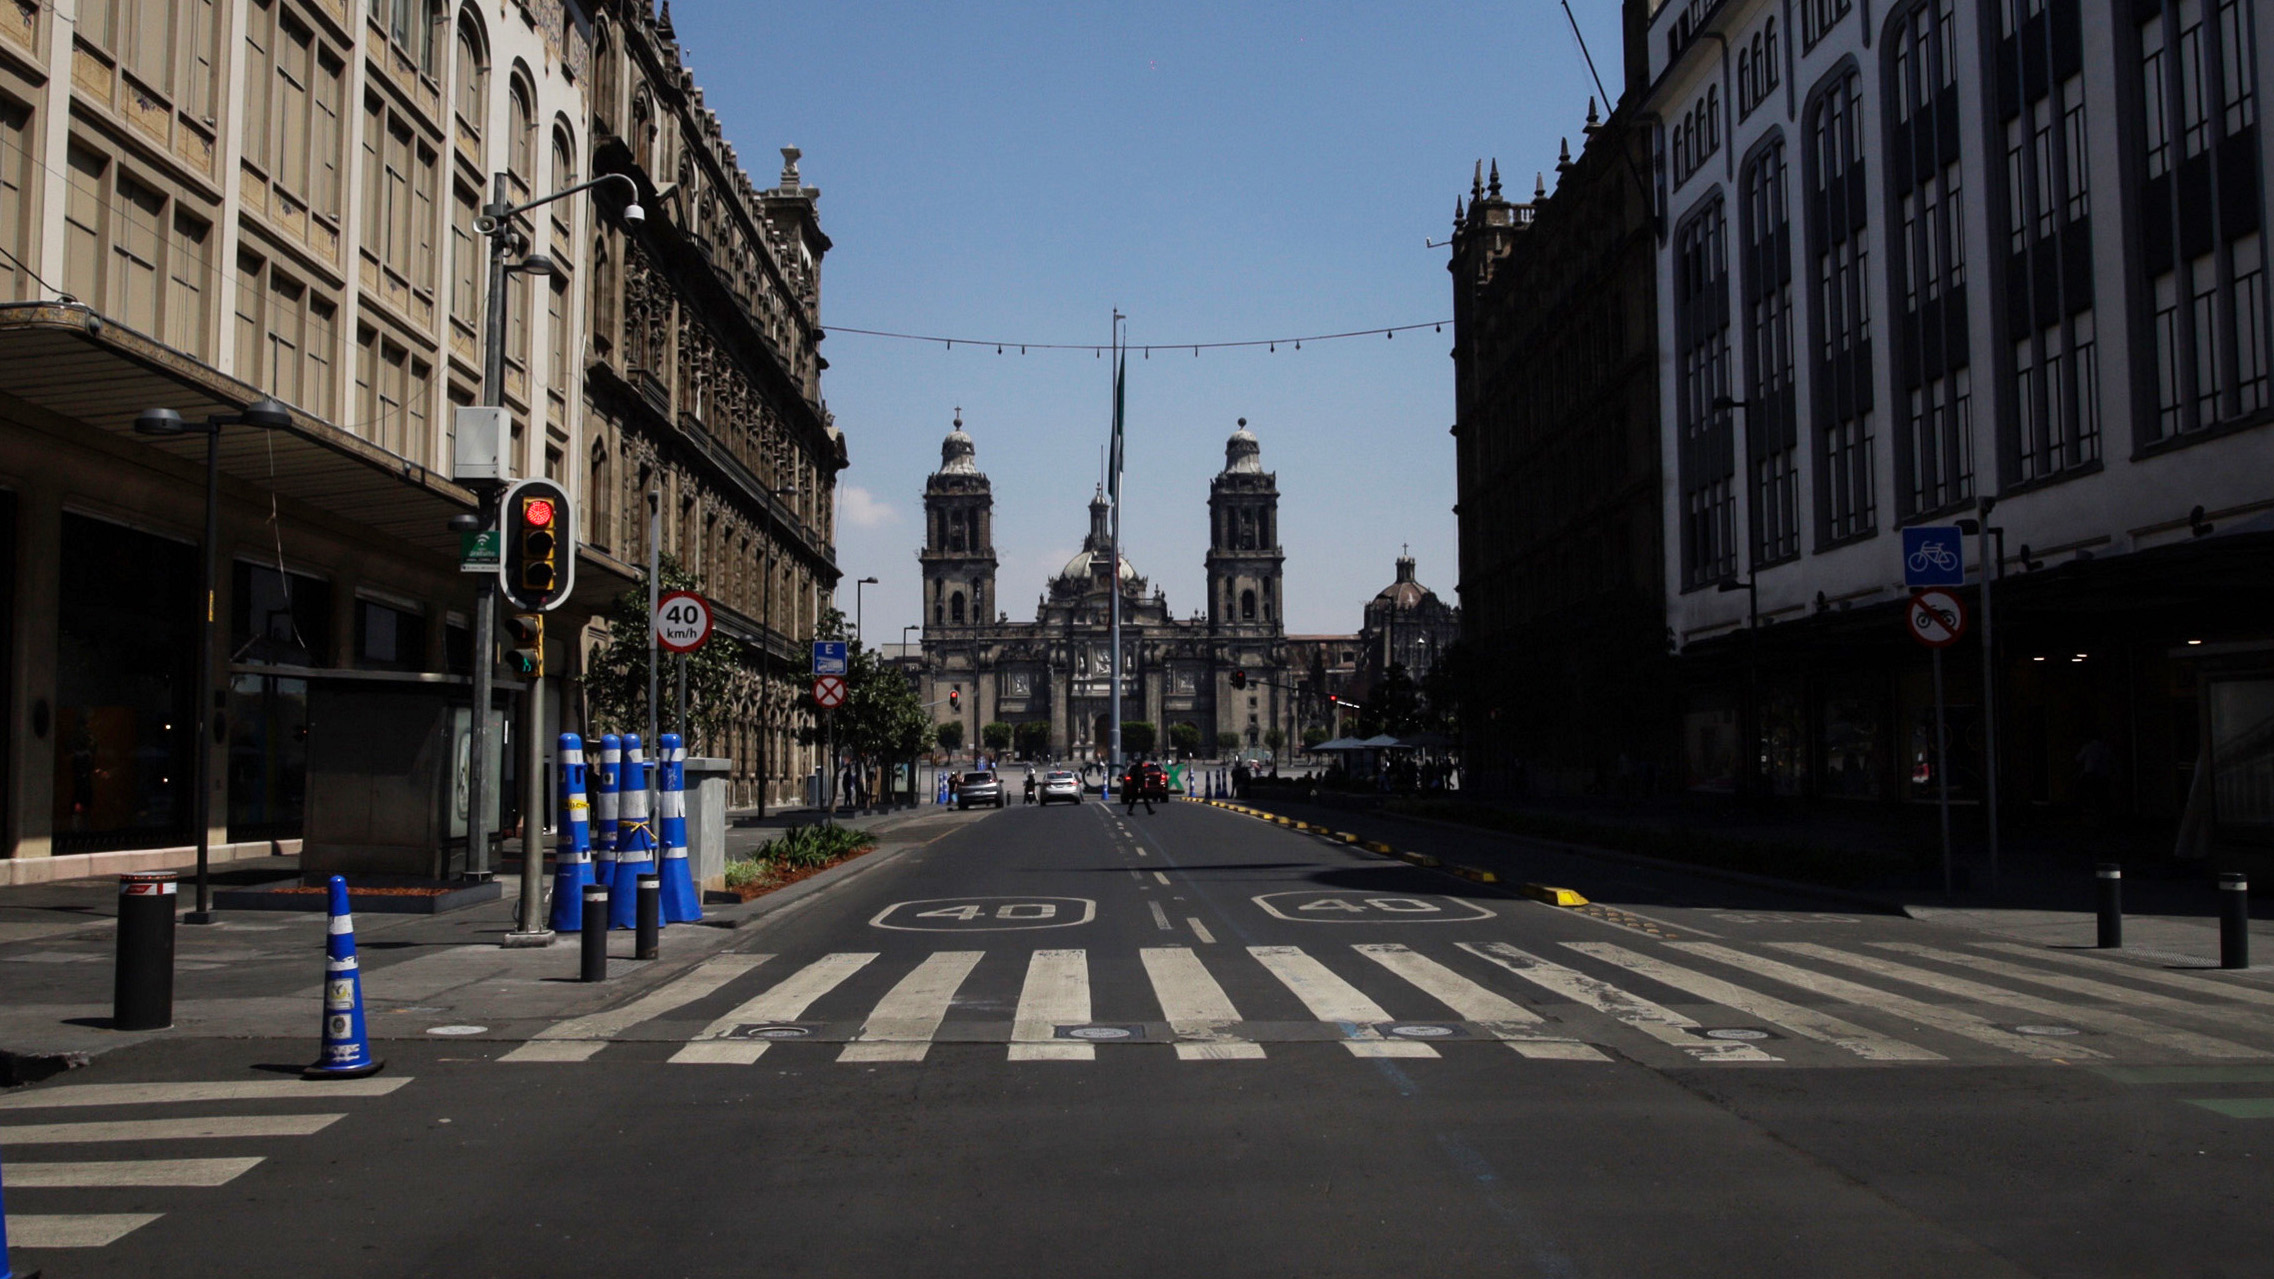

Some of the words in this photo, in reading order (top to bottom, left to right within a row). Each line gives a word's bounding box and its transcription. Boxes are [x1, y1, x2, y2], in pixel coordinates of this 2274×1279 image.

[666, 605, 698, 625] 40
[667, 627, 697, 638] km/h
[825, 644, 834, 654] E
[916, 904, 1056, 920] 40
[1298, 899, 1441, 912] 40
